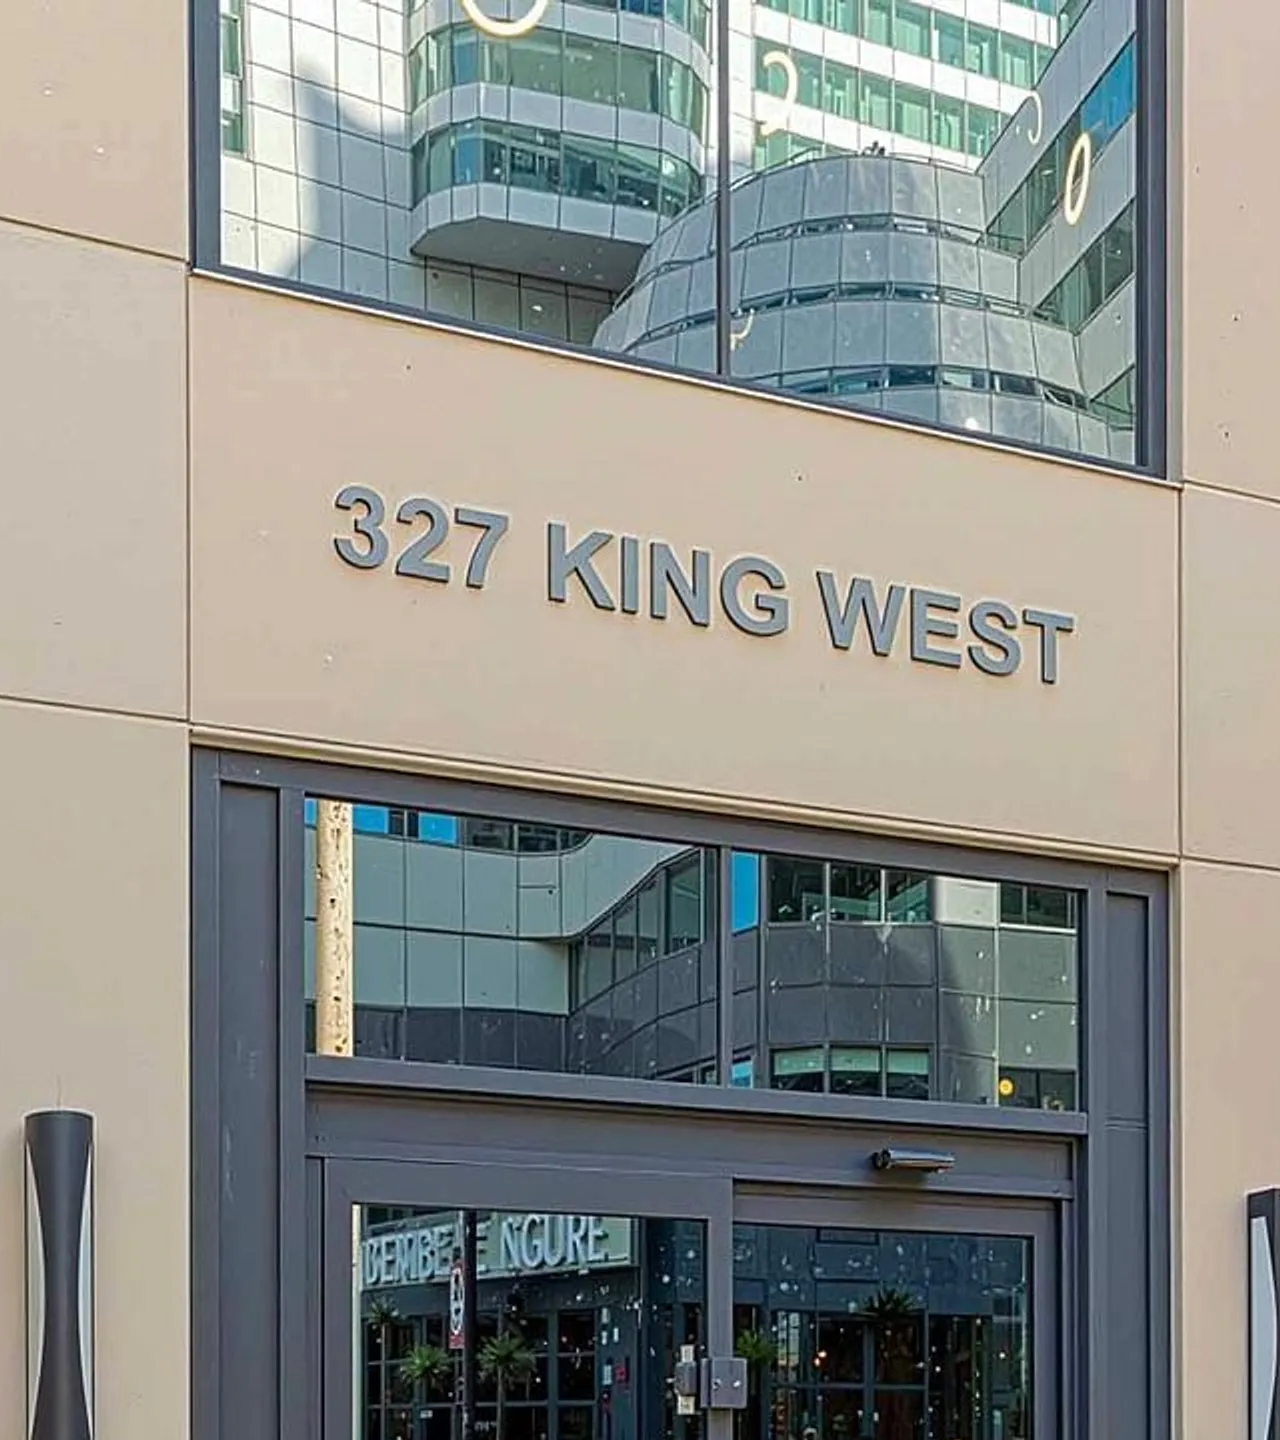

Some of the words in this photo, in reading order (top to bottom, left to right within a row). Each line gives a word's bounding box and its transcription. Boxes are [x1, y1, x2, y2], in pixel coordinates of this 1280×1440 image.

[332, 485, 510, 589] 327
[546, 521, 791, 638] KING
[816, 569, 1075, 684] WEST
